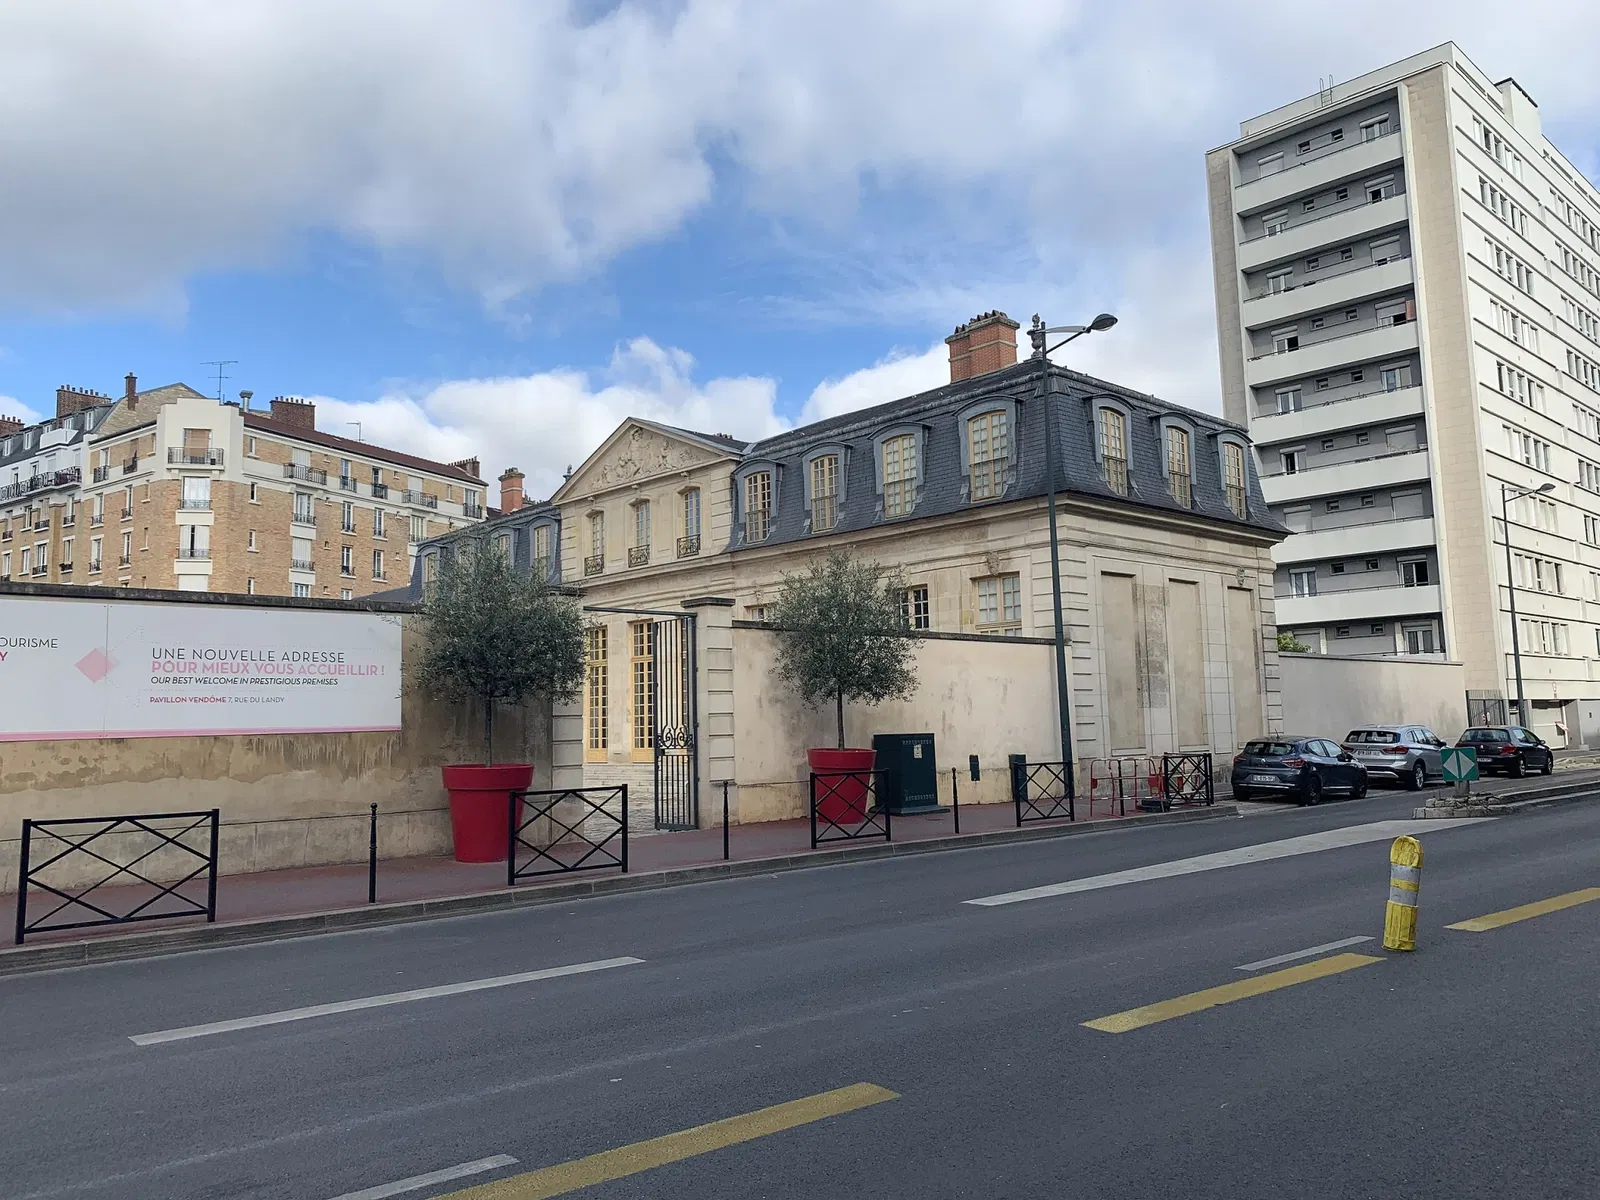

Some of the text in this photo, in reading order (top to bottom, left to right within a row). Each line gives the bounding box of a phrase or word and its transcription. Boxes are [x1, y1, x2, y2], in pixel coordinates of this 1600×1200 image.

[152, 648, 345, 663] UNE NOUVELLE ADRESSE
[152, 661, 197, 673] POUR
[202, 662, 250, 674] MIEUX
[254, 663, 294, 674] VOUS
[298, 664, 378, 675] ACCUEILLIR
[151, 676, 171, 684] OUR
[189, 695, 226, 703] VENDÔME
